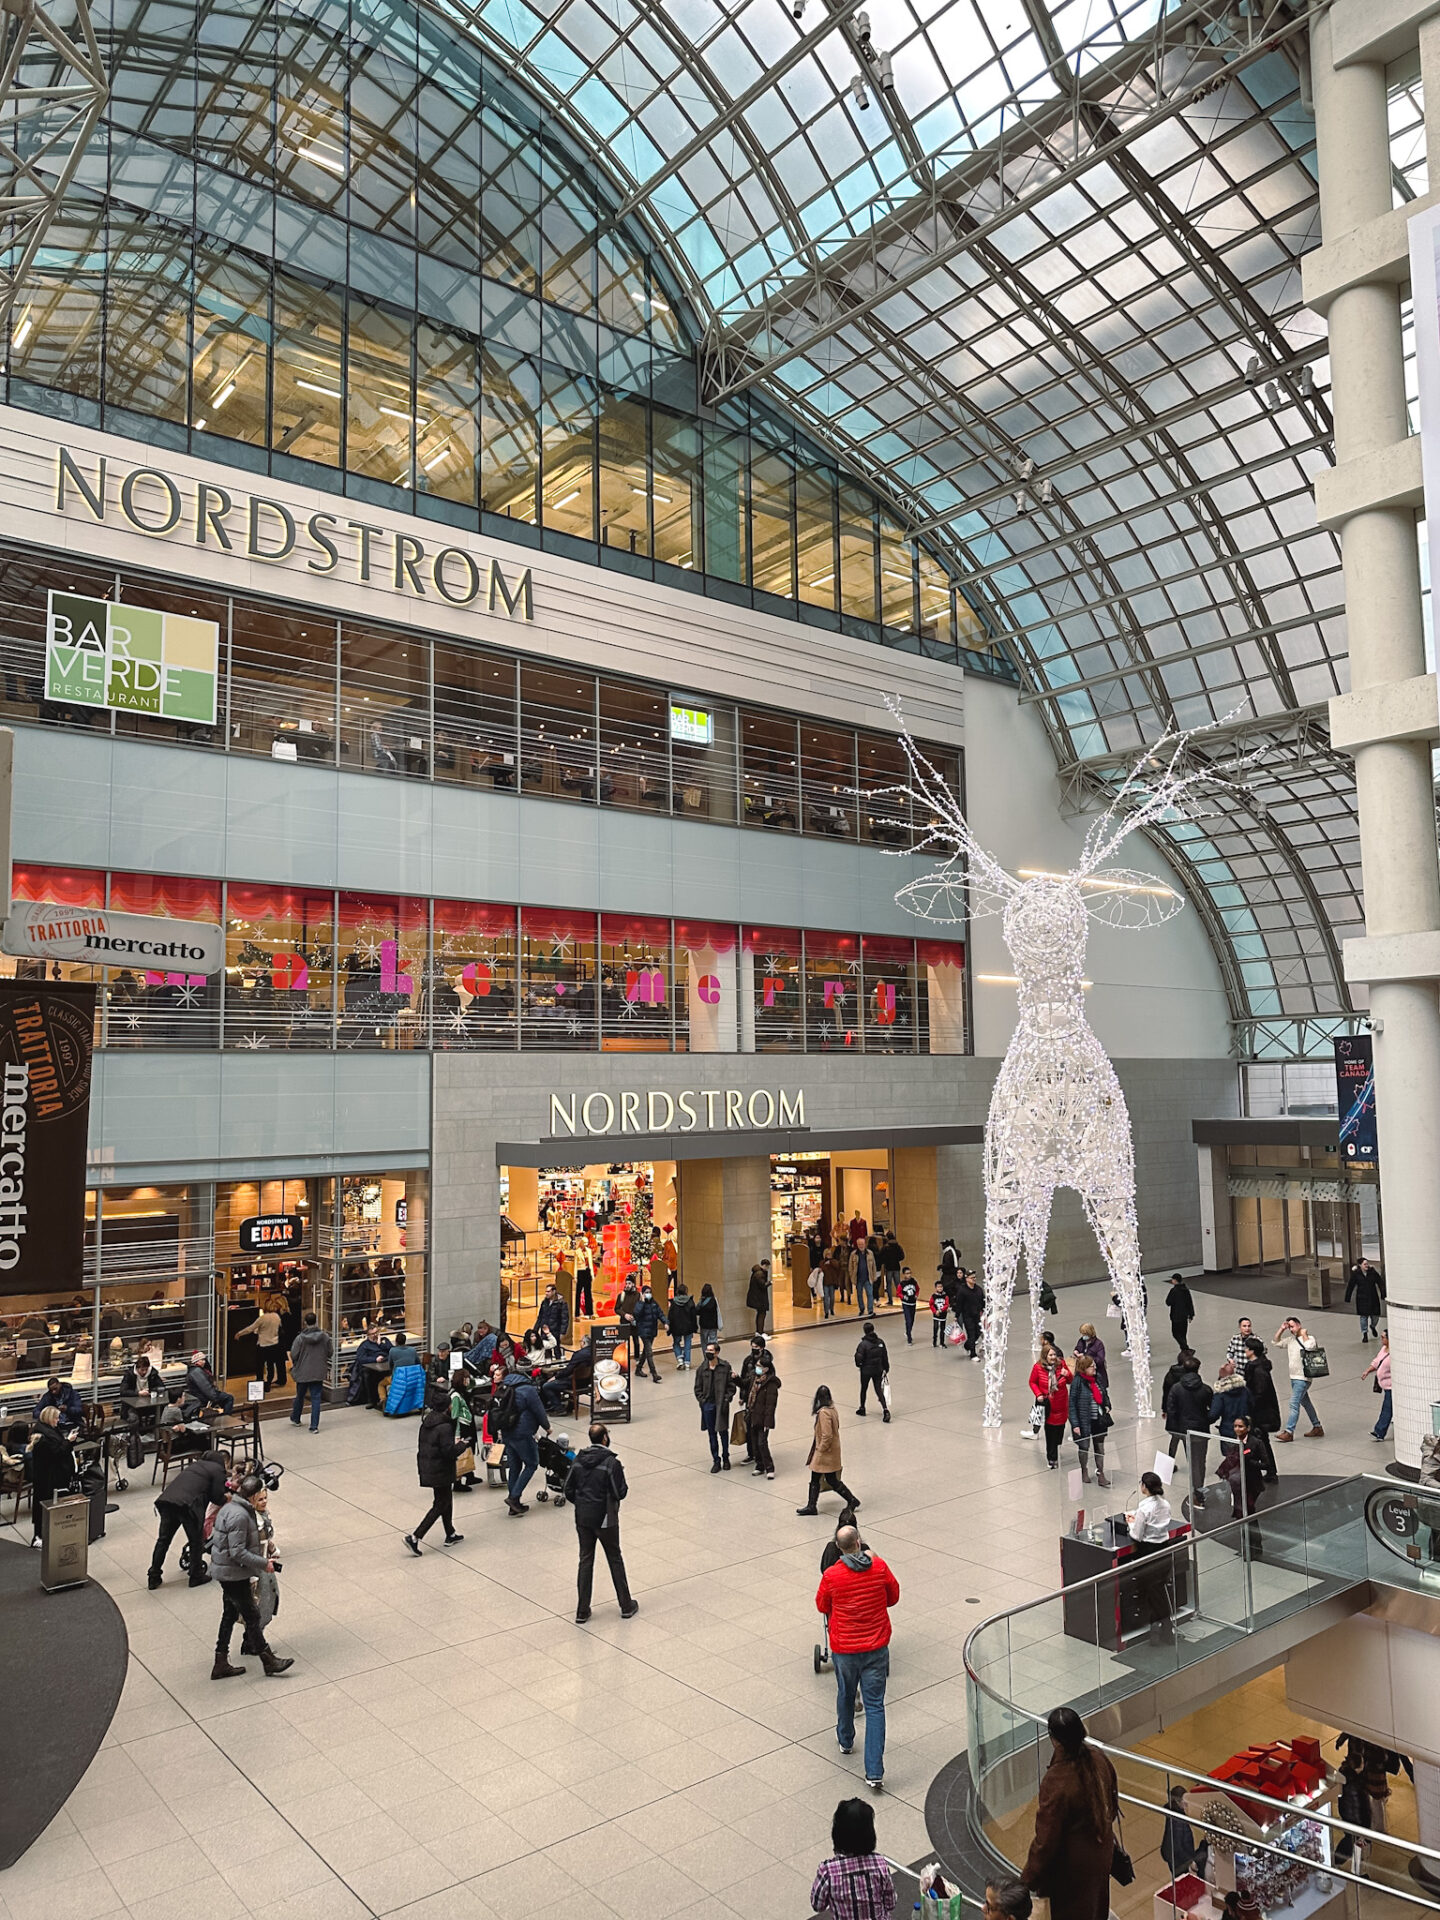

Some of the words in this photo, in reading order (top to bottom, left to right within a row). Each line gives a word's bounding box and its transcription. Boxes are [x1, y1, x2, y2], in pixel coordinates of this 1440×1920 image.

[56, 446, 534, 621] NORDSTROM
[51, 614, 132, 658] BAR
[51, 646, 183, 697] VERDE
[53, 683, 160, 709] RESTAURANT
[27, 917, 106, 942] TRATTORIA
[83, 934, 206, 960] mercatto
[13, 1001, 63, 1116] TRATTORIA
[59, 1039, 75, 1067] 1997
[1340, 1070, 1371, 1078] CANADA
[551, 1089, 805, 1137] NORDSTROM
[0, 1061, 29, 1270] mercatto
[250, 1225, 293, 1242] EBAR
[1389, 1504, 1411, 1518] Level
[1395, 1515, 1406, 1533] 3
